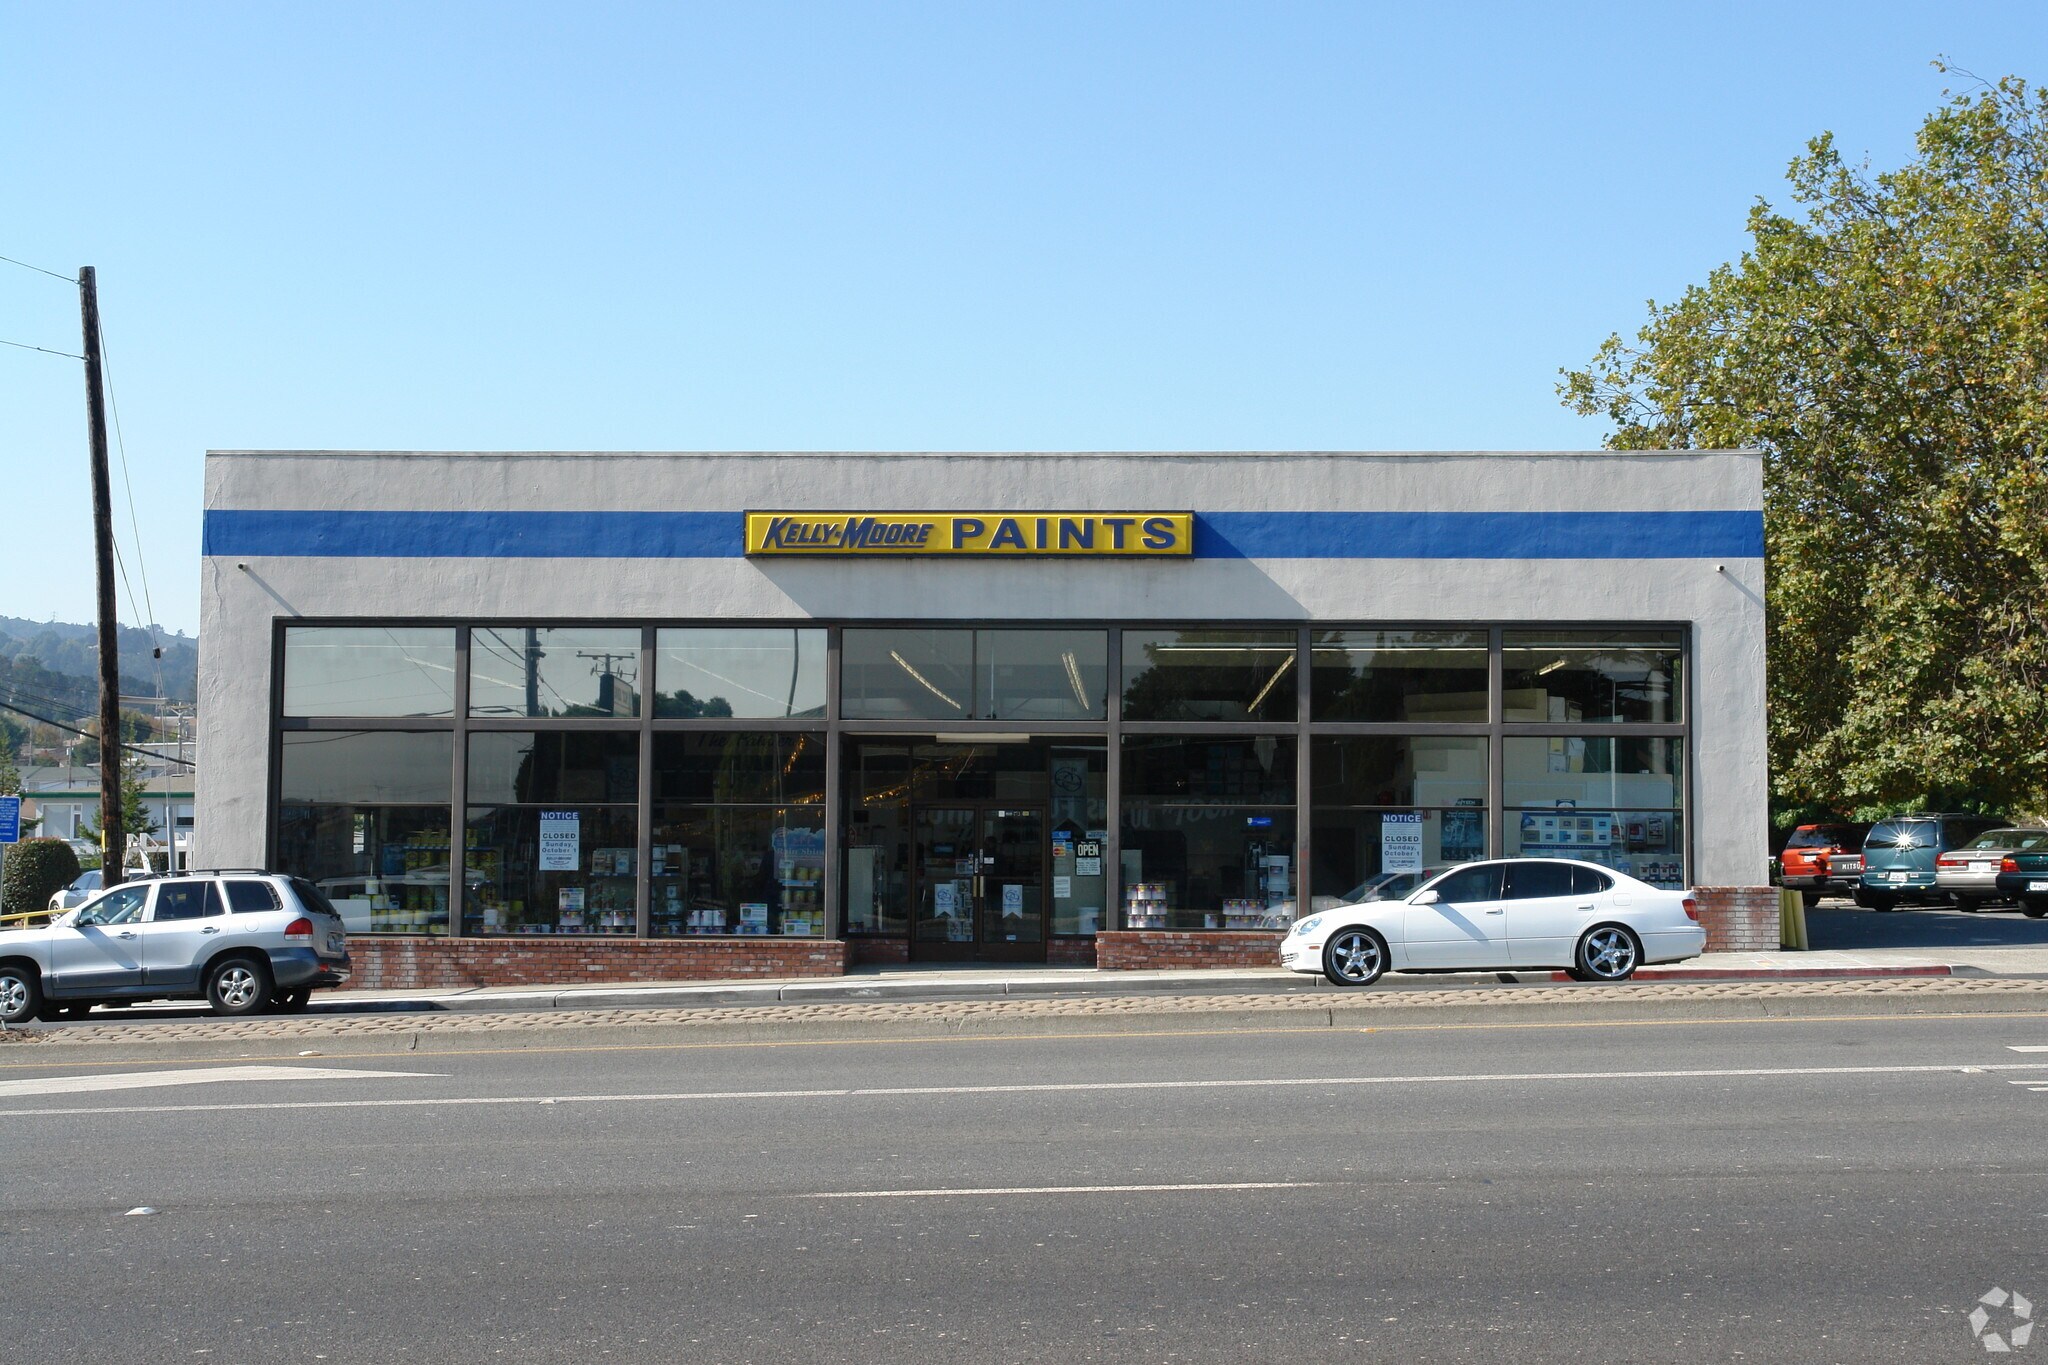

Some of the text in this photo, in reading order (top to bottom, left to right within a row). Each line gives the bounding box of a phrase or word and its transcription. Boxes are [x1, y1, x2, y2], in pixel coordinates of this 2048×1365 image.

[761, 517, 1176, 550] KELLY-MOORE PAINTS
[541, 812, 578, 820] NOTICE
[1383, 814, 1421, 822] NOTICE
[1077, 844, 1099, 857] OPEN
